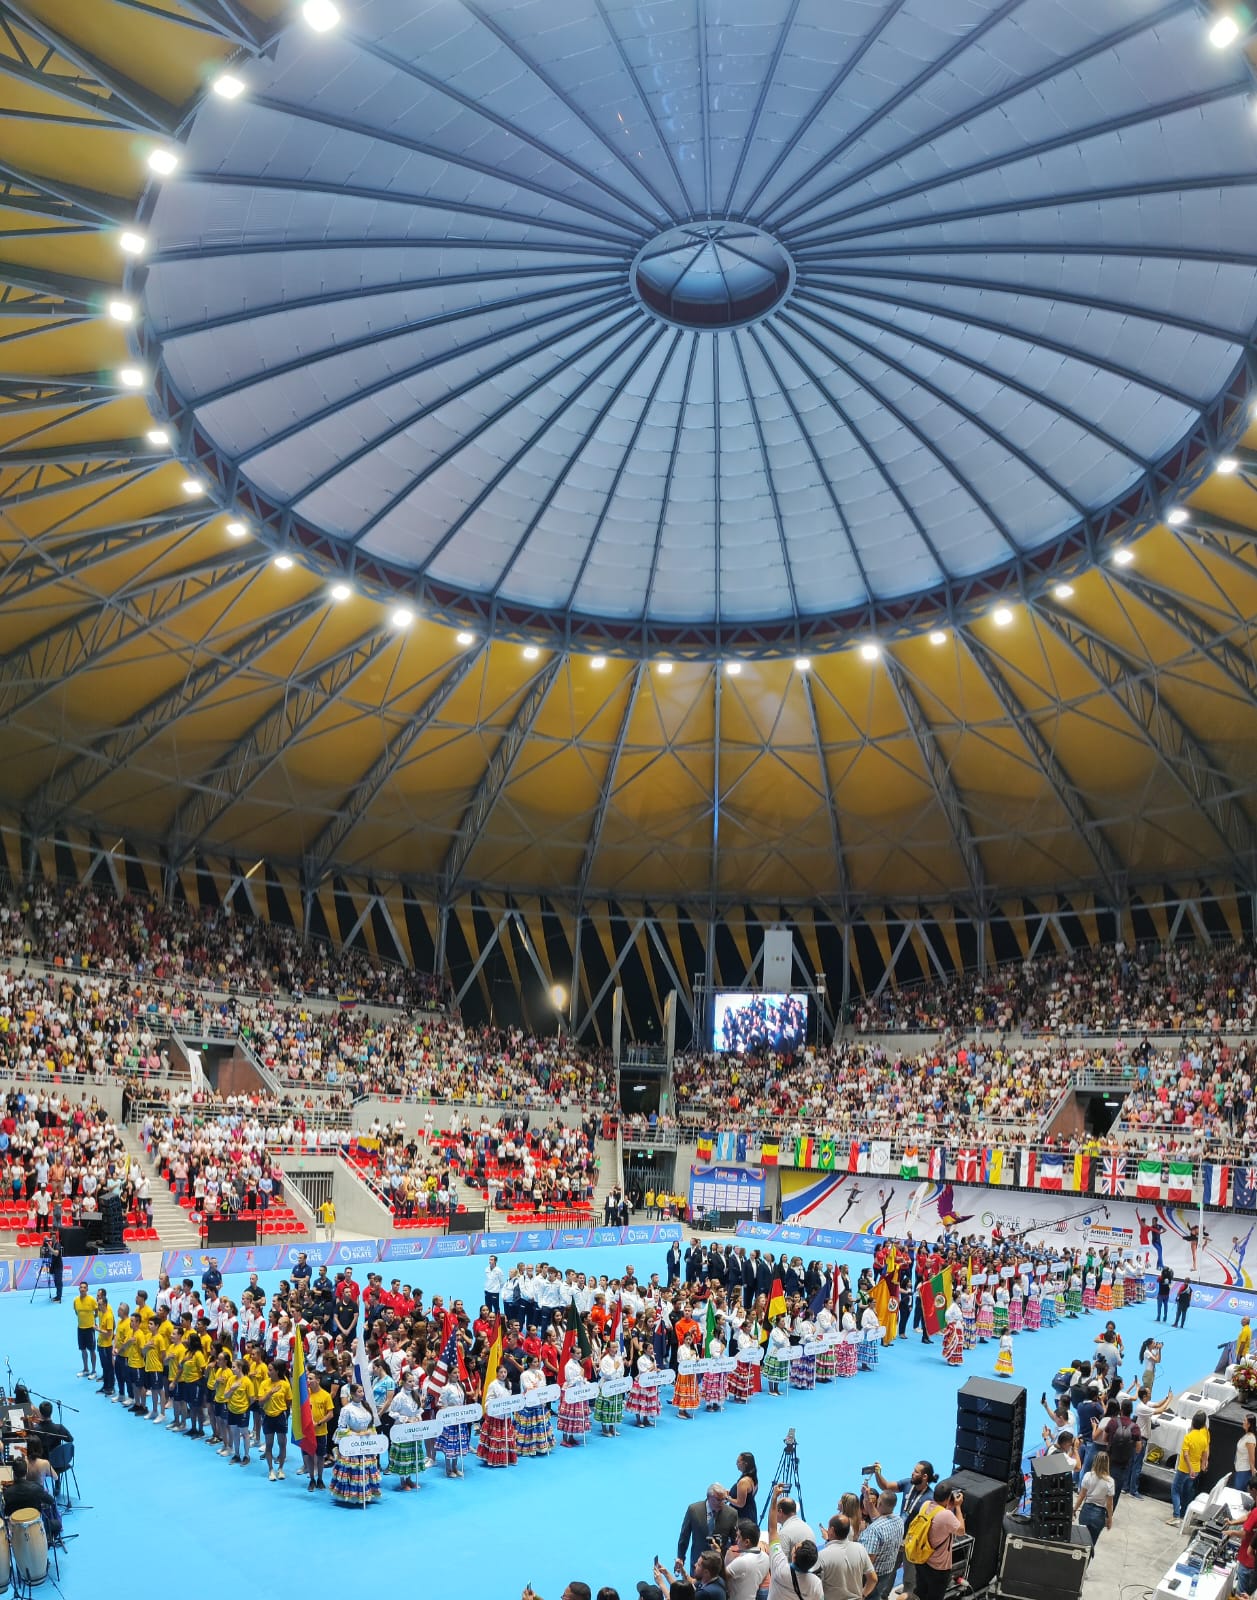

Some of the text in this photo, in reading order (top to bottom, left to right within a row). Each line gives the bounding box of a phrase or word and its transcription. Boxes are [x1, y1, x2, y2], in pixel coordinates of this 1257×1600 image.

[1001, 1221, 1020, 1230] KATE
[352, 1251, 372, 1259] SKATE
[107, 1260, 131, 1268] WORLD
[108, 1267, 133, 1276] SKATE
[442, 1409, 477, 1419] UNITED STATES
[404, 1426, 430, 1434] URUGUAY
